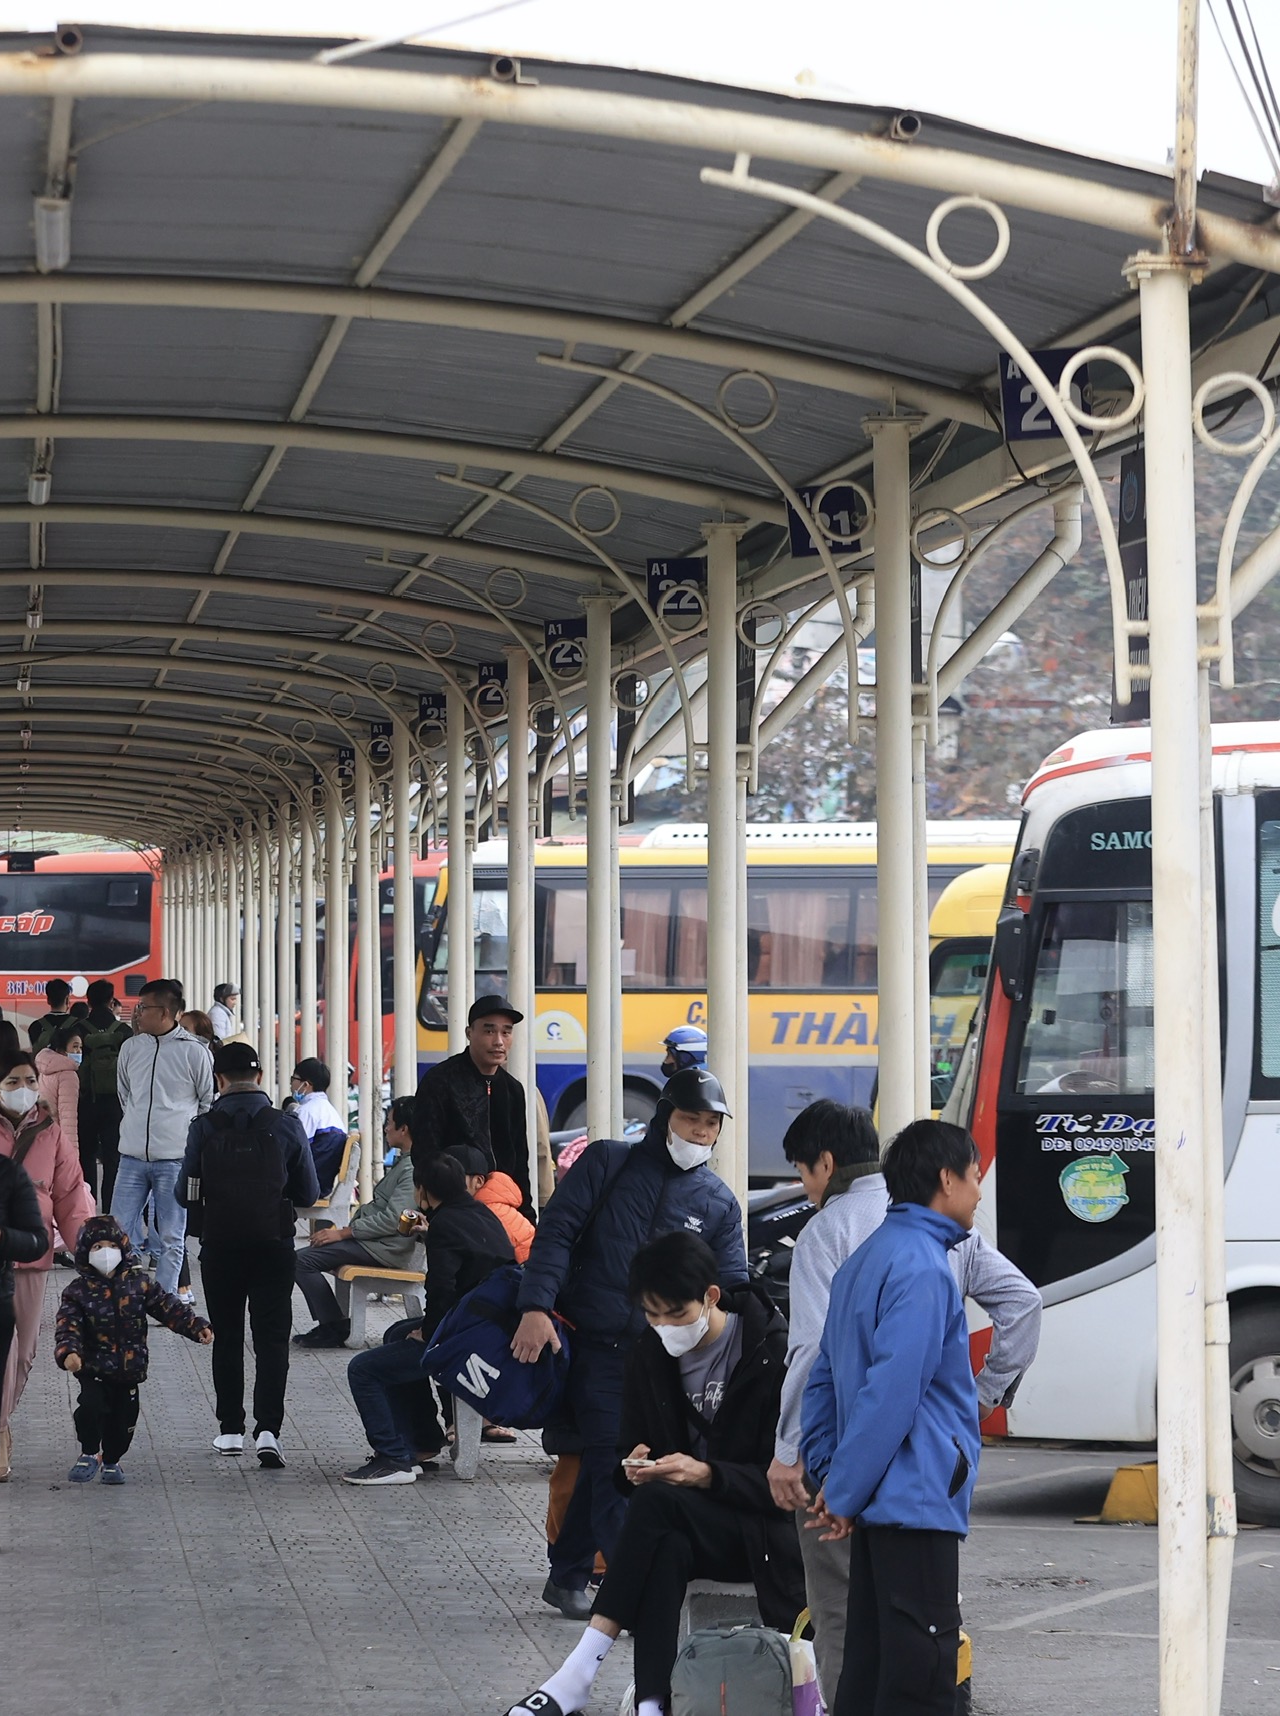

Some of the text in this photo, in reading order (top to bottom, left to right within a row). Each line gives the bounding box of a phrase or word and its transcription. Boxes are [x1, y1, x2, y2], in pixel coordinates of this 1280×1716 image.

[651, 562, 668, 577] A1
[658, 579, 699, 610] 22
[547, 623, 563, 636] A1
[481, 666, 495, 677] A1
[421, 696, 434, 706] A1
[372, 724, 383, 734] A1
[770, 1002, 879, 1046] THÀ
[1094, 1113, 1155, 1137] Đạ
[1041, 1138, 1072, 1151] DĐ:
